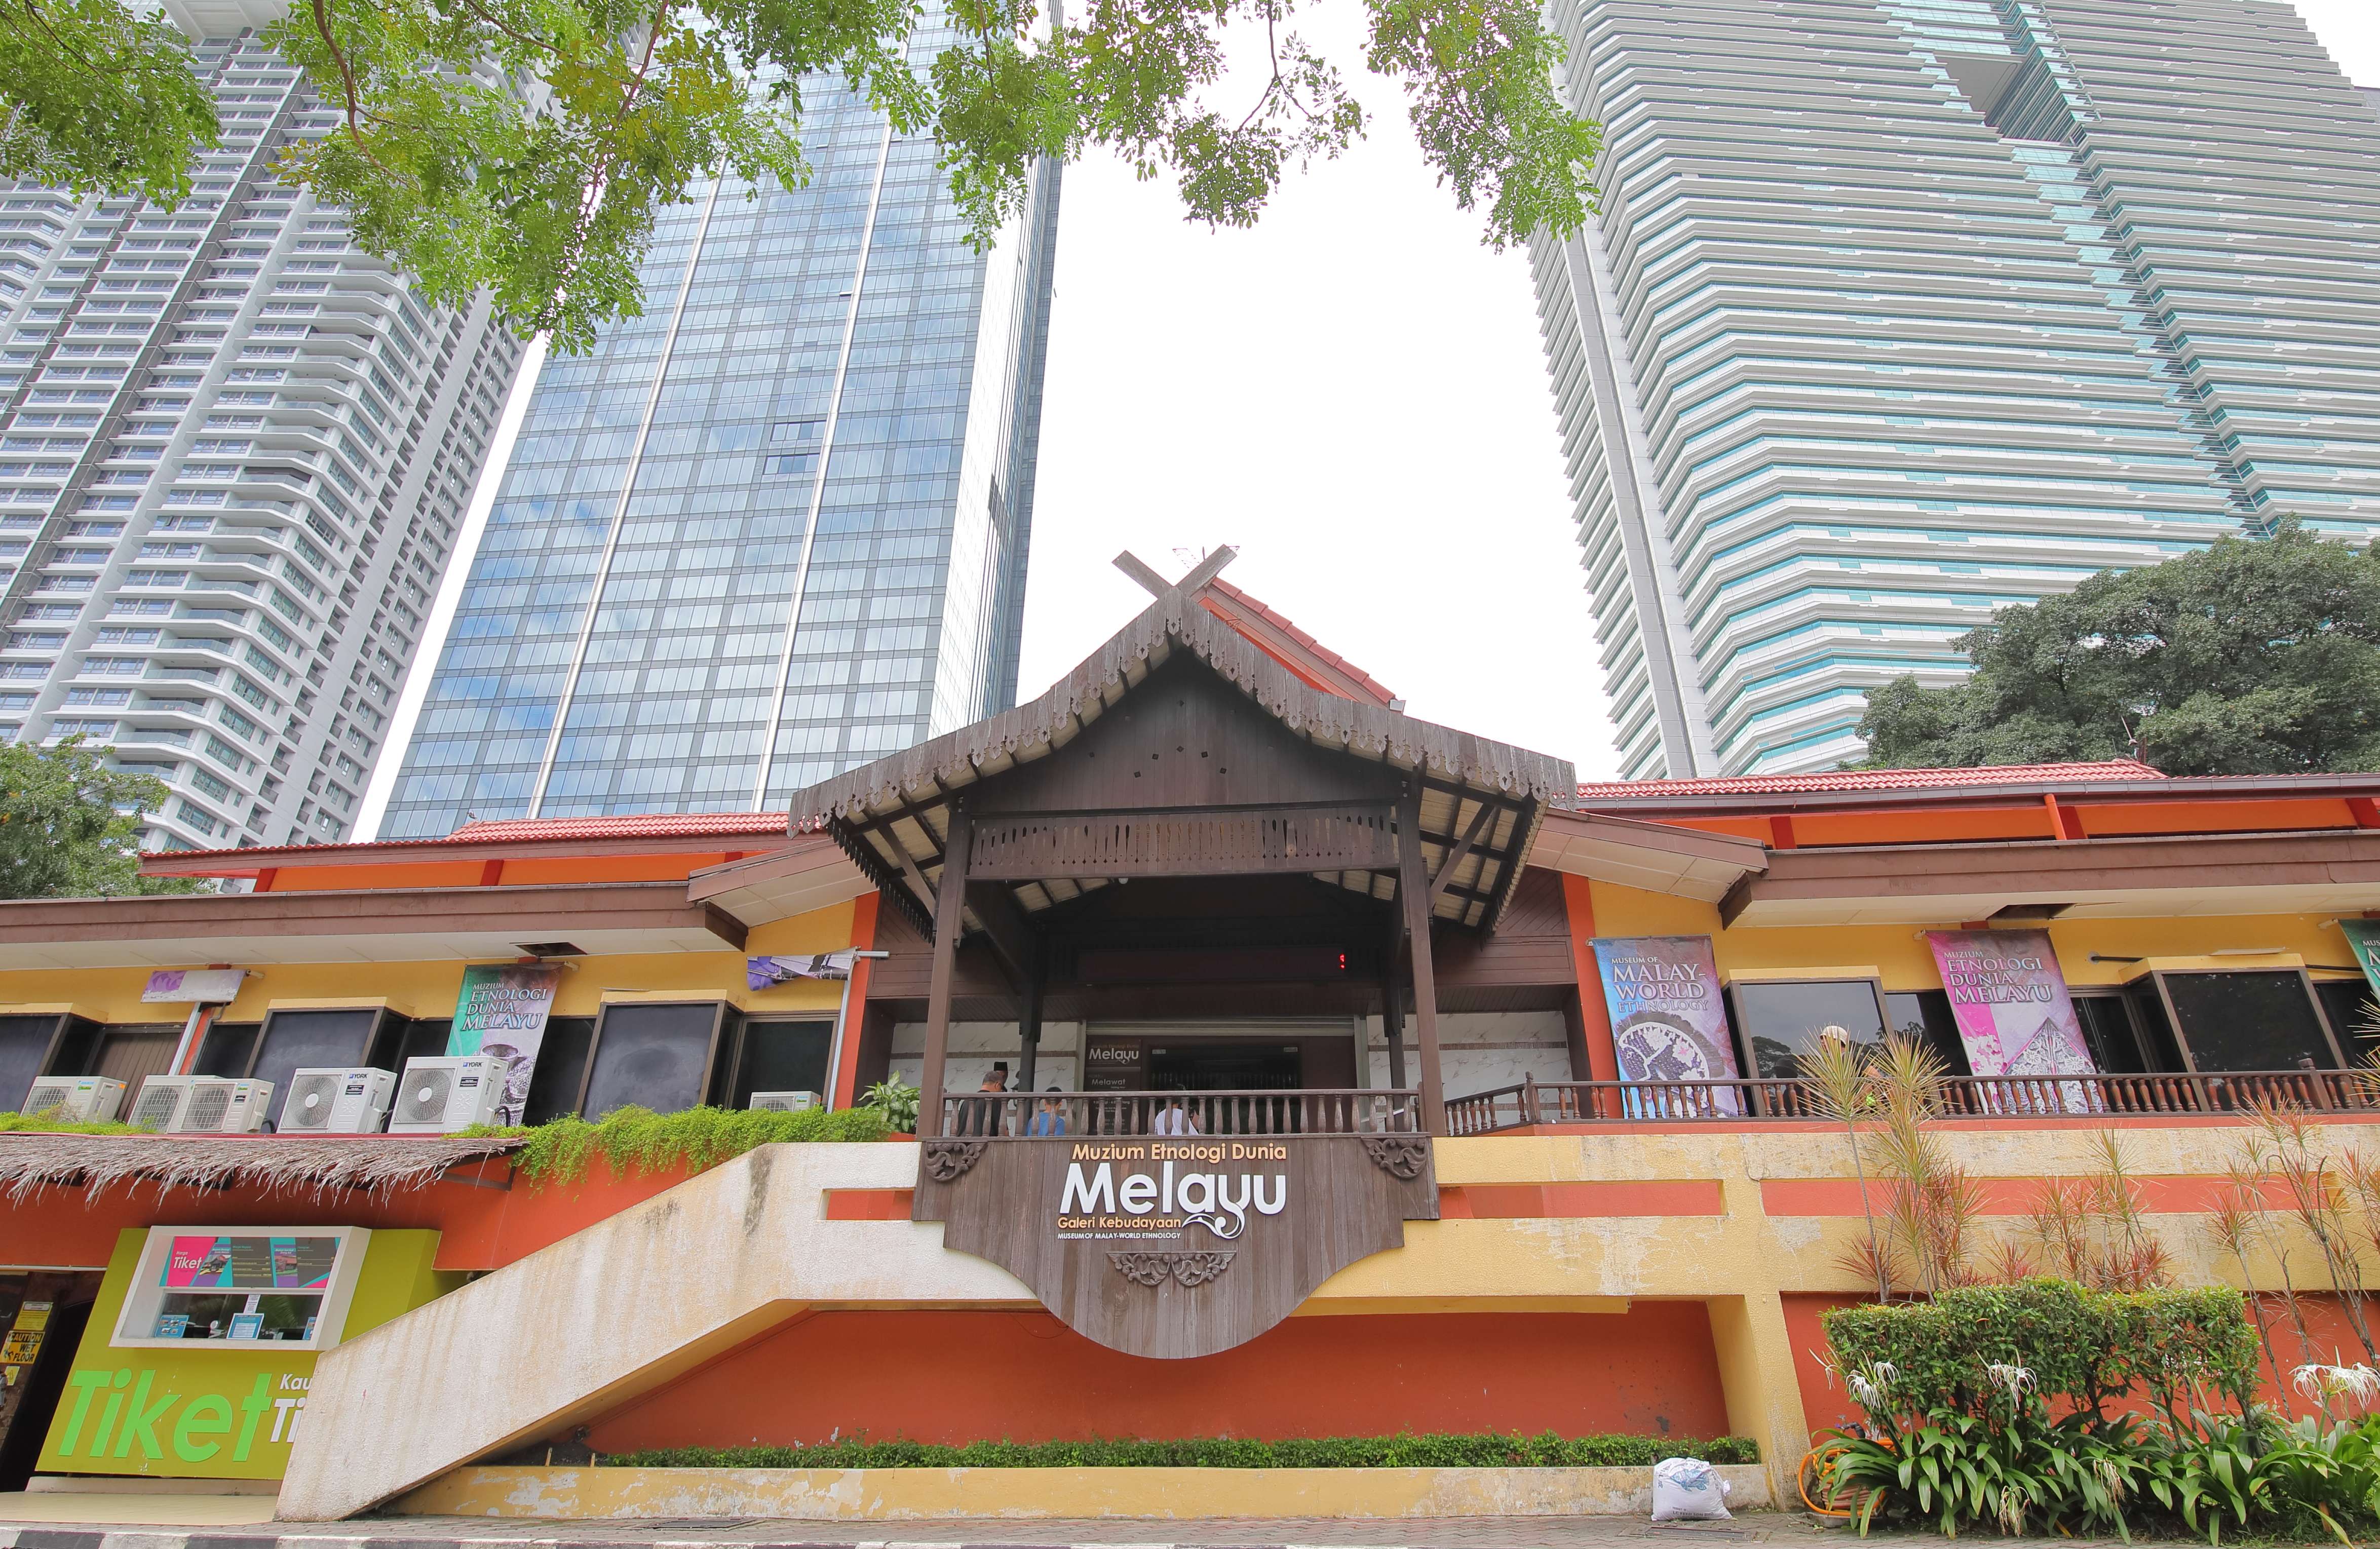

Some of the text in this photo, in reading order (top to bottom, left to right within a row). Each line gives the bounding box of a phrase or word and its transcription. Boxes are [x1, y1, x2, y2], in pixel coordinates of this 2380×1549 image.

[1613, 963, 1706, 983] MALAY-
[1946, 957, 2043, 973] ETNOLOGI
[1949, 972, 2014, 987] DUNIA
[471, 989, 547, 1002] ETNOLOGI
[1614, 983, 1705, 1000] WORLD
[1954, 985, 2052, 1004] MELAYU
[466, 1001, 515, 1015] DUNIA
[1618, 1000, 1708, 1013] ETHNOLOGY
[462, 1013, 543, 1031] MELAYU
[1089, 1048, 1139, 1064] Melayu
[1072, 1143, 1287, 1164] Muzium Etnologi Dunia
[1059, 1160, 1286, 1240] Melayu
[1057, 1216, 1181, 1231] Galeri Kebudayaan
[173, 1256, 202, 1269] Tiket
[11, 1333, 41, 1342] CAUTION
[14, 1353, 34, 1362] FLOOR
[58, 1368, 273, 1462] Tiket
[271, 1398, 306, 1442] Ti
